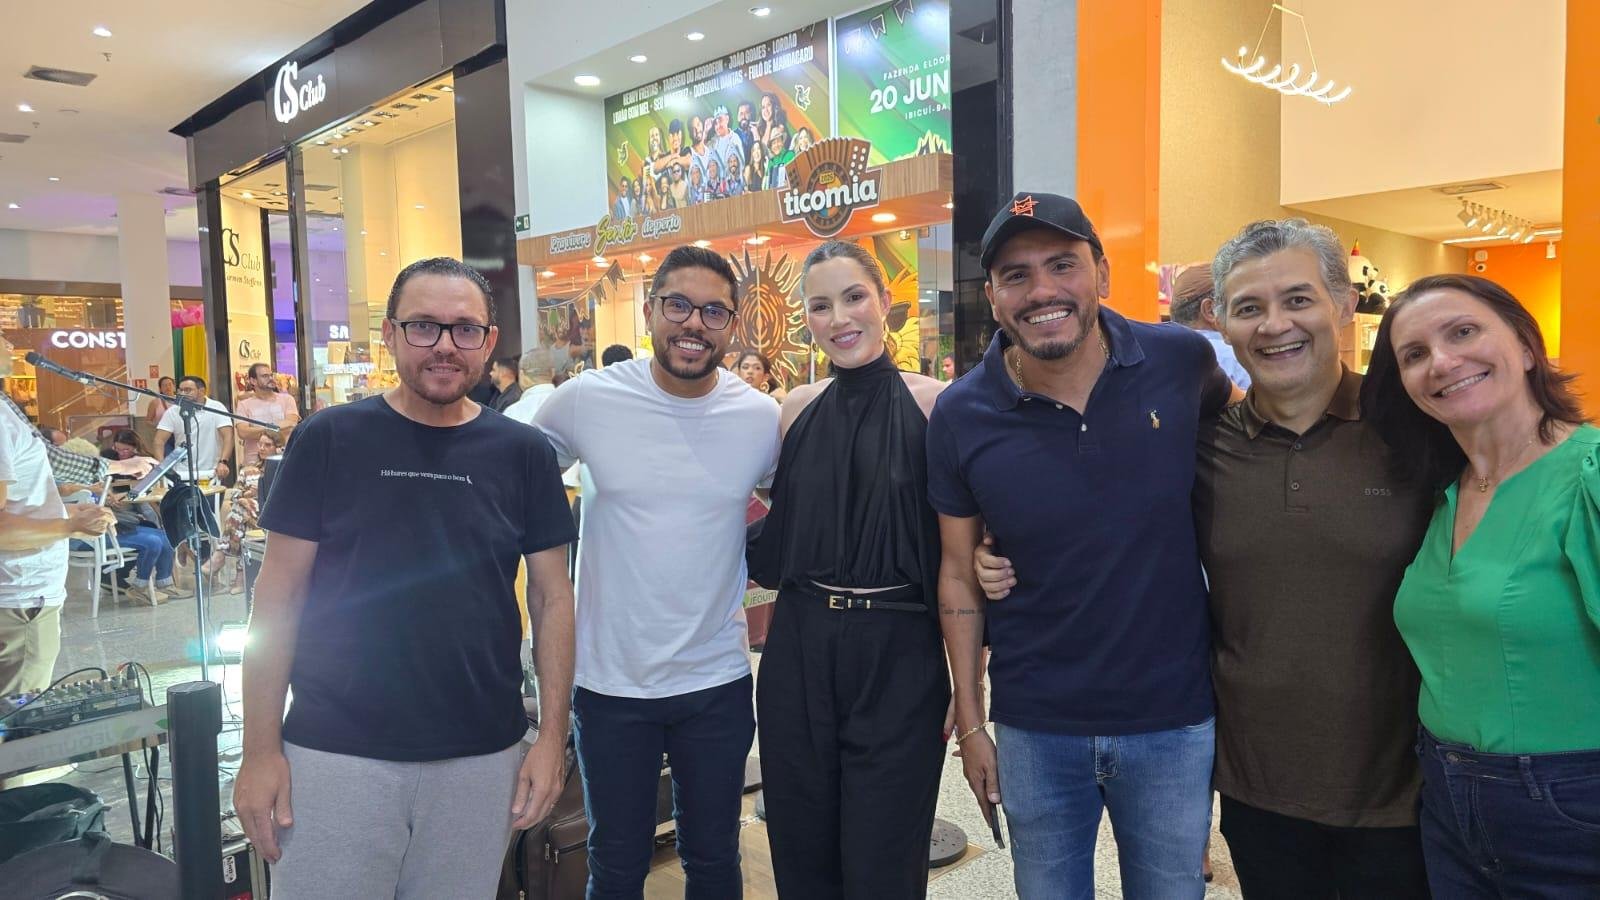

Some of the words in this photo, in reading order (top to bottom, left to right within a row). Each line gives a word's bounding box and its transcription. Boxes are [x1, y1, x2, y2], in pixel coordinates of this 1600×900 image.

[745, 44, 766, 63] GOMES
[763, 60, 772, 74] DE
[883, 64, 919, 80] FAZENDA
[300, 74, 326, 111] Club
[870, 85, 898, 114] 20
[902, 69, 949, 105] JUN
[784, 175, 877, 216] ticomia
[241, 253, 261, 271] Club
[51, 330, 126, 349] CONST
